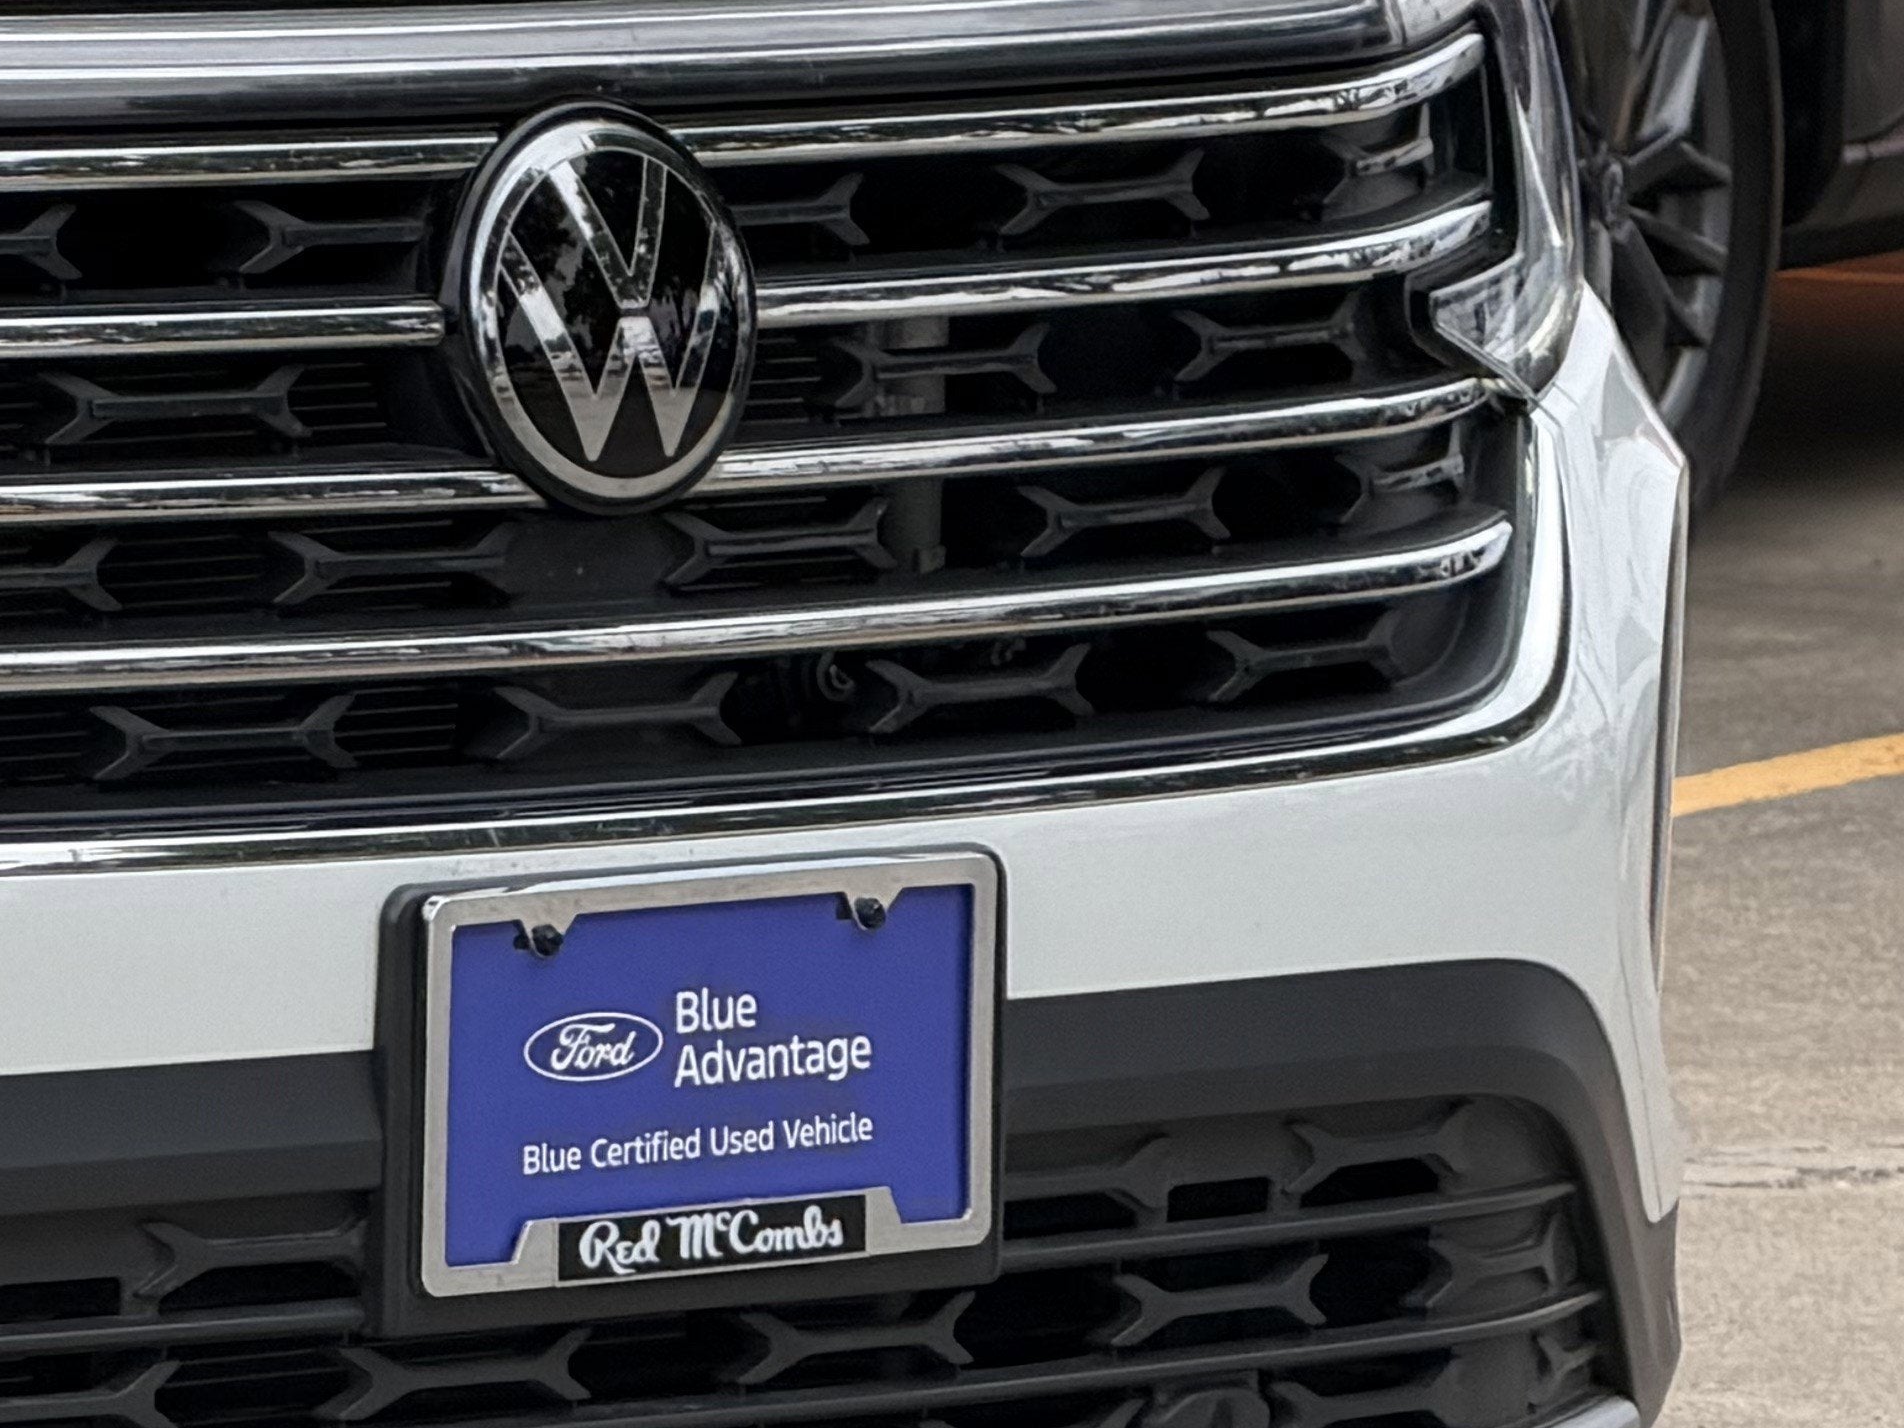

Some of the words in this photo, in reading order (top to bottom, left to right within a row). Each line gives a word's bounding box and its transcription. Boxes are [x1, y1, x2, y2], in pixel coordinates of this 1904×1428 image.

[675, 987, 758, 1034] Blue
[550, 1021, 638, 1072] Ford
[673, 1034, 872, 1088] Advantage
[523, 1143, 582, 1175] Blue
[590, 1127, 701, 1168] Certified
[709, 1120, 774, 1156] Used
[782, 1111, 874, 1149] Vehicle
[578, 1220, 662, 1275] Red
[666, 1204, 845, 1261] McCombs
